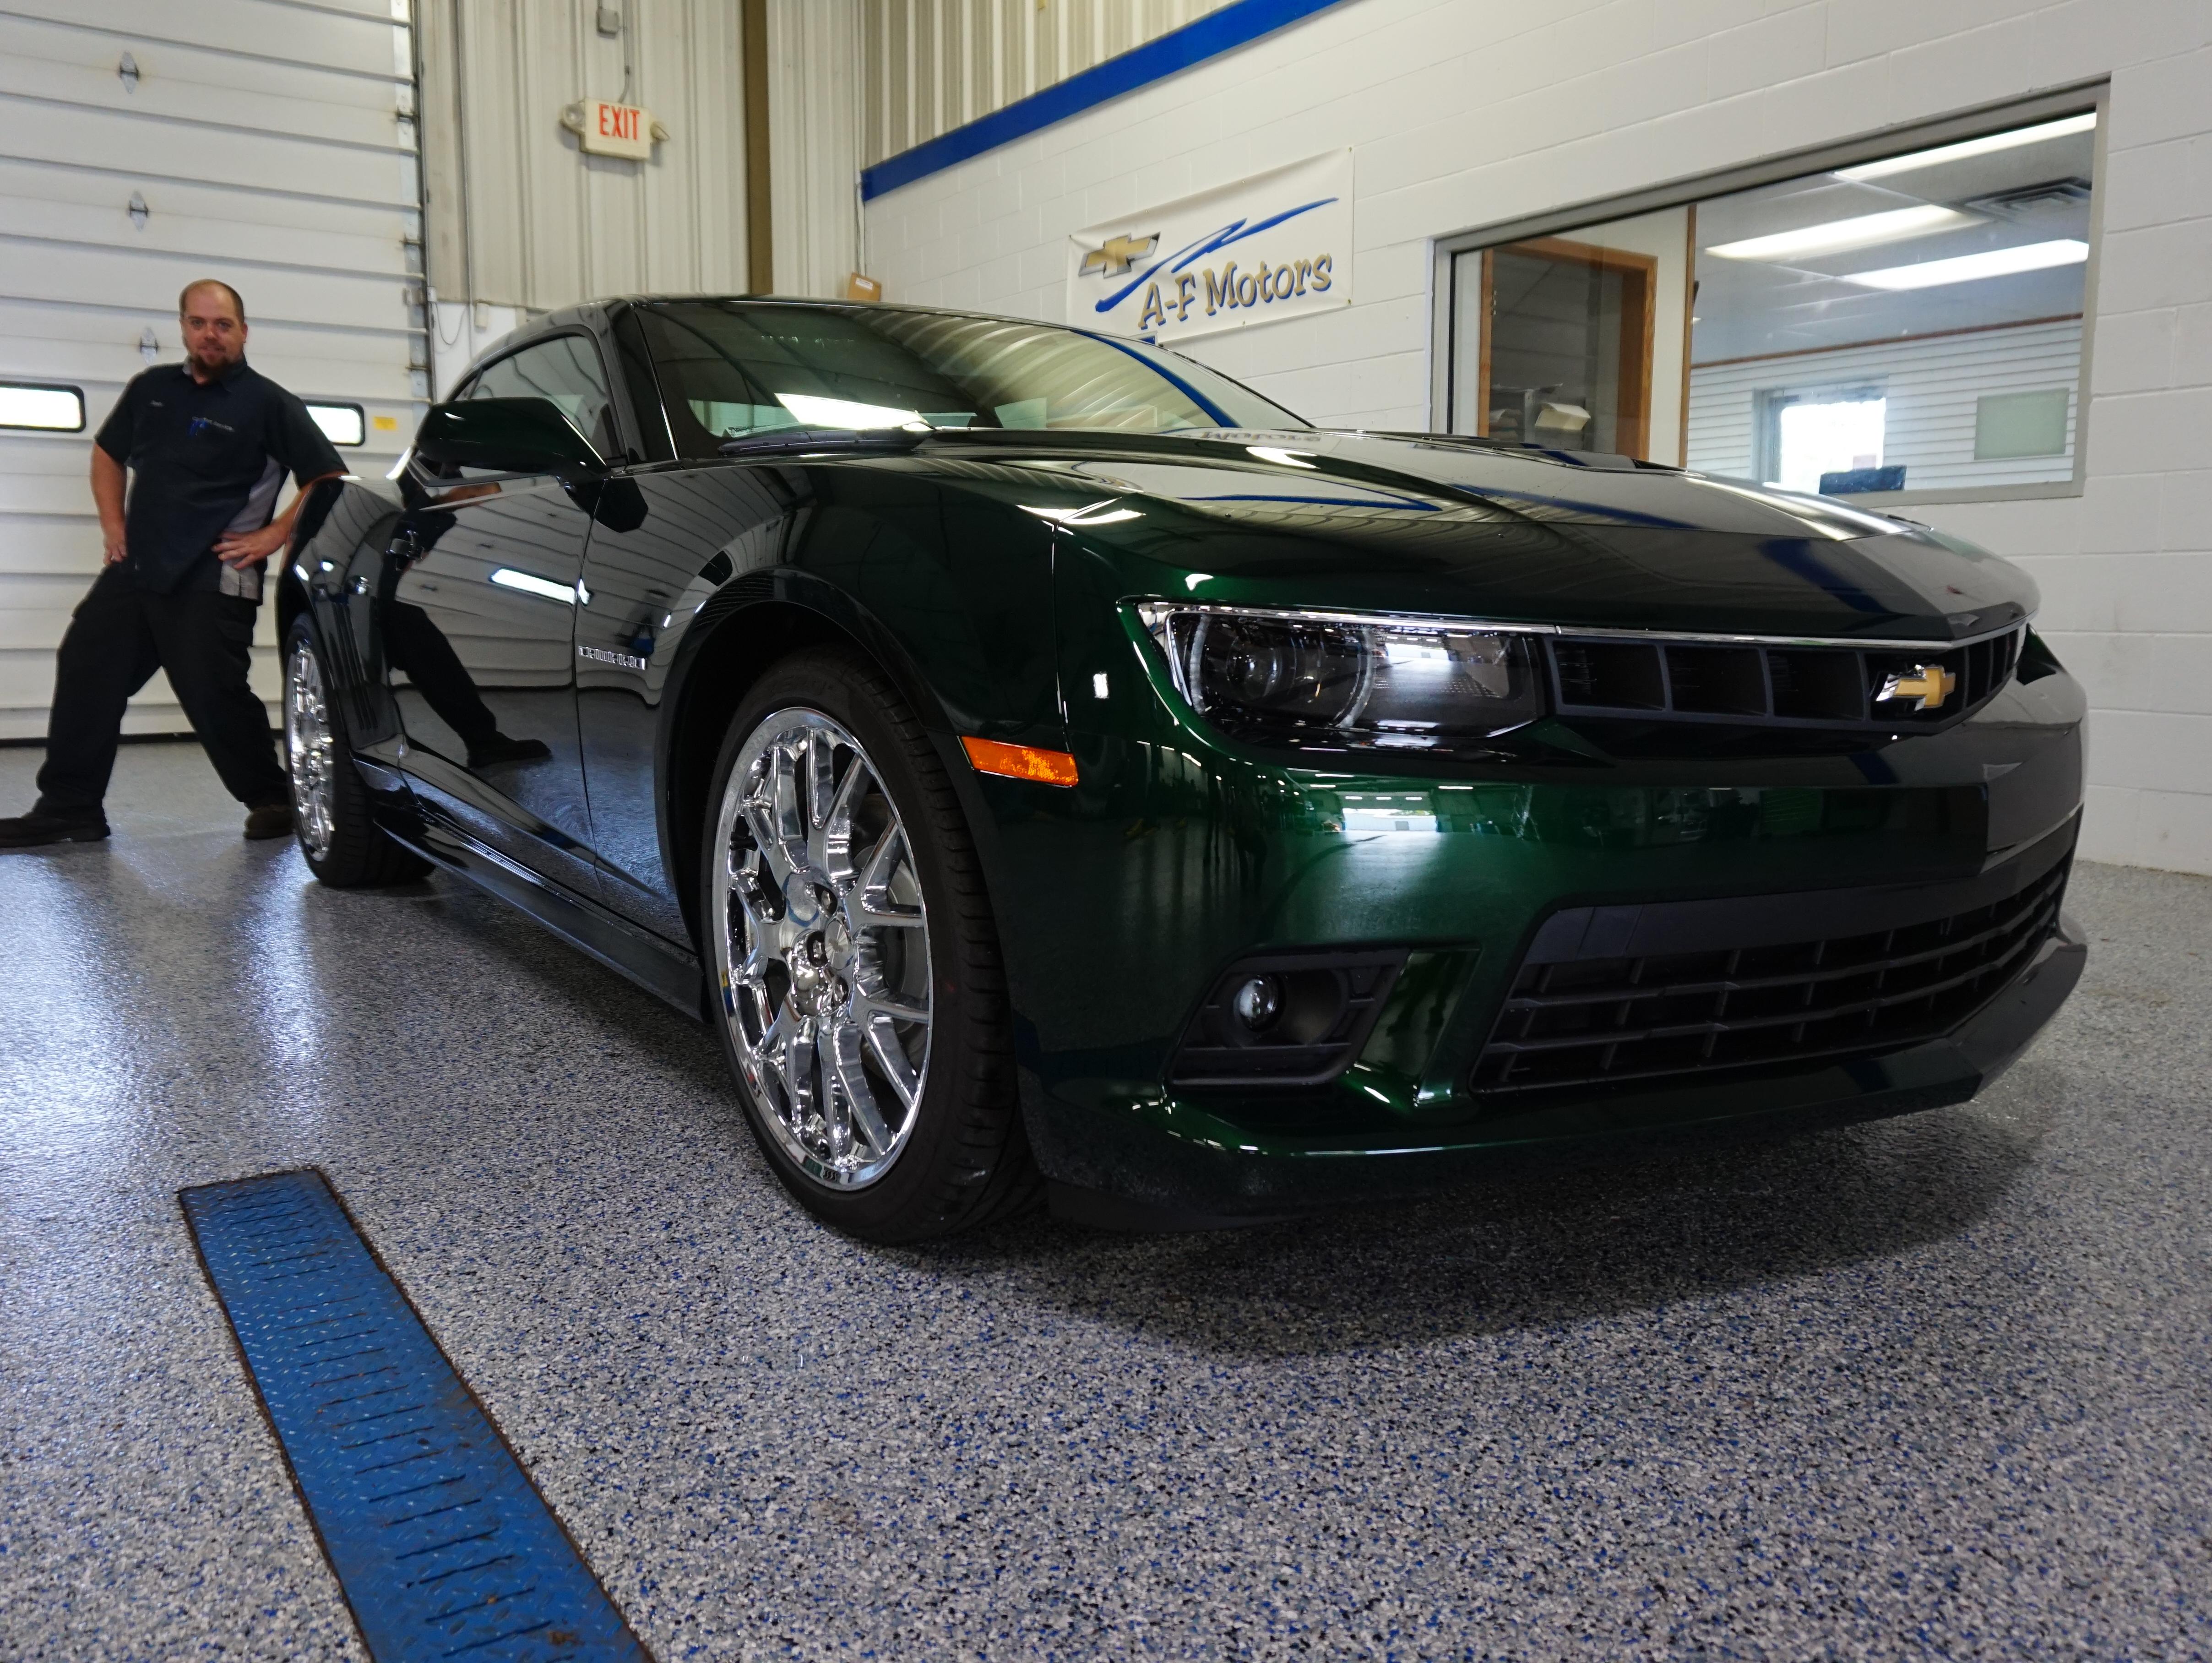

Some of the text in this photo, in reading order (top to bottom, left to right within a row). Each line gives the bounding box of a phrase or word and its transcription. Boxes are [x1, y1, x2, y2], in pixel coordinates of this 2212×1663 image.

[598, 103, 640, 140] EXIT
[1137, 253, 1332, 330] A-F Motors
[578, 645, 646, 670] CAMARO
